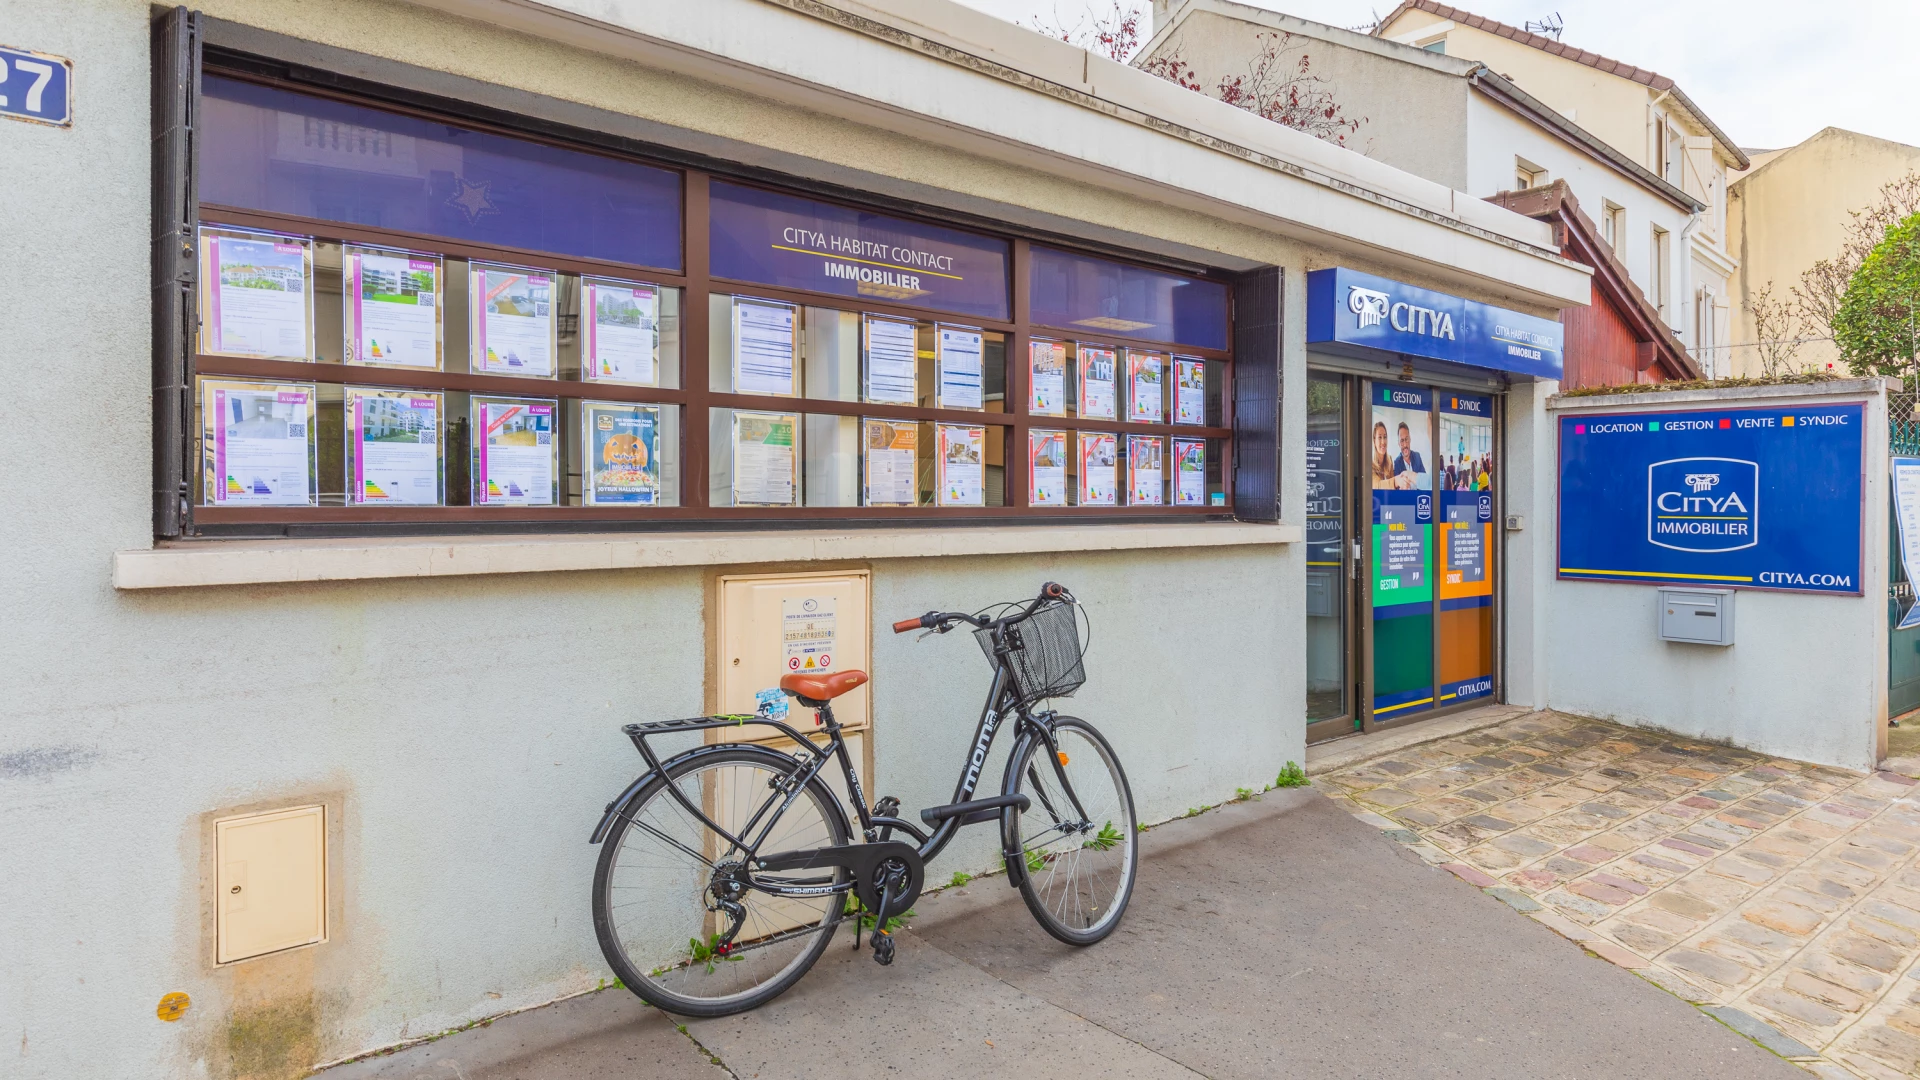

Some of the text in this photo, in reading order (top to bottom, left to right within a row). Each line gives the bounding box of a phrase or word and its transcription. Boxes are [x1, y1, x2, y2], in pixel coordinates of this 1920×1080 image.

[0, 56, 53, 113] 7
[783, 227, 954, 271] CITYA HABITAT CONTACT
[824, 262, 921, 290] IMMOBILIER
[1390, 302, 1456, 341] CITYA
[1495, 324, 1553, 347] CITYA HABITAT CONTACT
[1508, 345, 1542, 361] IMMOBILIER
[1392, 391, 1422, 405] GESTION
[1459, 399, 1481, 412] SYNDIC
[1590, 414, 1848, 434] LOCATION GESTION VENTE SYNDIC
[1657, 492, 1748, 513] CITYA
[1657, 522, 1748, 535] IMMOBILIER
[1380, 578, 1399, 591] GESTION
[1446, 573, 1461, 584] SYNDIC
[1759, 571, 1851, 587] CITYA.COM
[1457, 680, 1492, 697] CITYA.COM
[963, 709, 996, 793] moma
[782, 783, 806, 812] Aluminium
[849, 768, 868, 809] City Classic
[793, 886, 833, 894] SHIMANO
